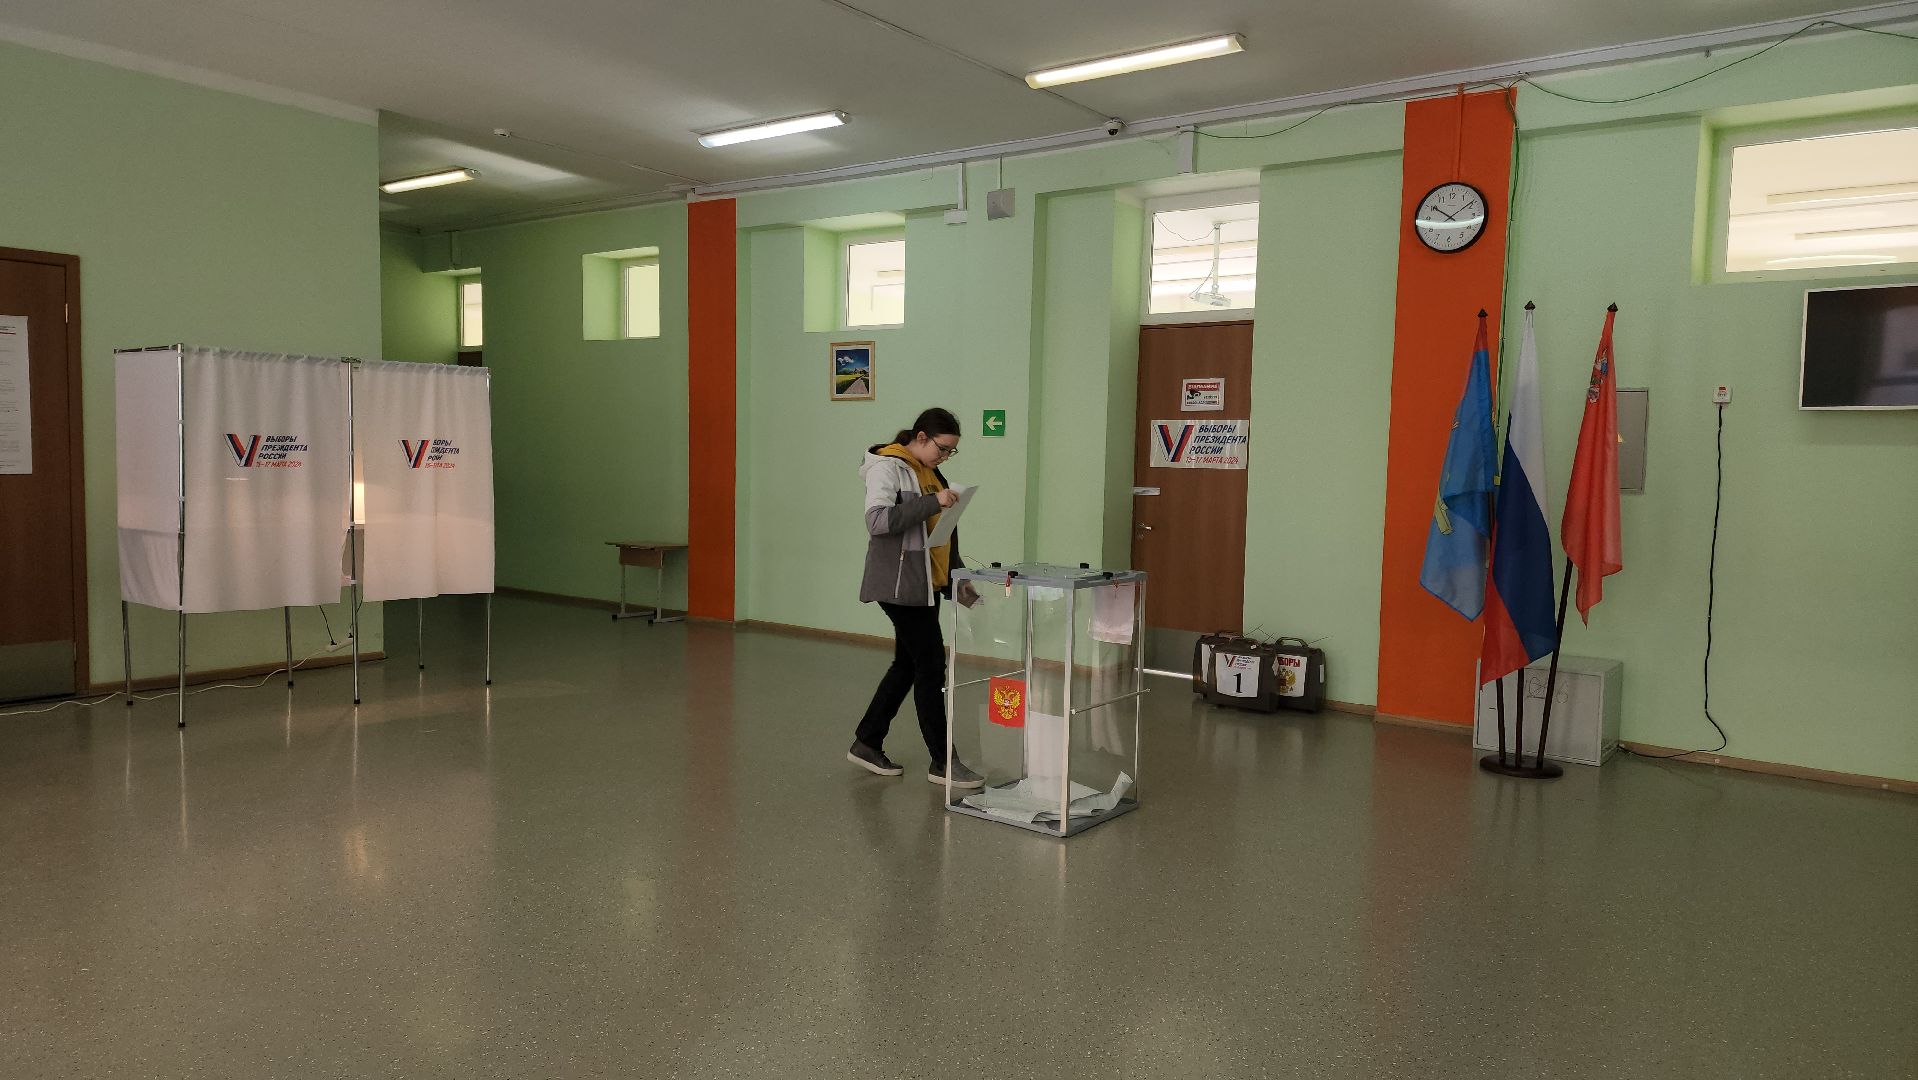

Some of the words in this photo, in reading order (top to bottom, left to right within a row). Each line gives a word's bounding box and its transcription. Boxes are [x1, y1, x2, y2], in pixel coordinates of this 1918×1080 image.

[1449, 192, 1456, 200] 12
[1198, 424, 1237, 434] ВЫБОРЫ
[265, 435, 298, 443] ВЫБОРЫ
[1193, 435, 1248, 445] ПРЕЗИДЕНТА
[260, 444, 308, 452] ПРЕЗИДЕНТА
[1188, 446, 1224, 455] РОССИИ
[258, 452, 288, 460] РОССИИ
[1223, 456, 1239, 464] 2024
[1278, 657, 1300, 668] БОРЫ
[1232, 672, 1243, 694] 1
